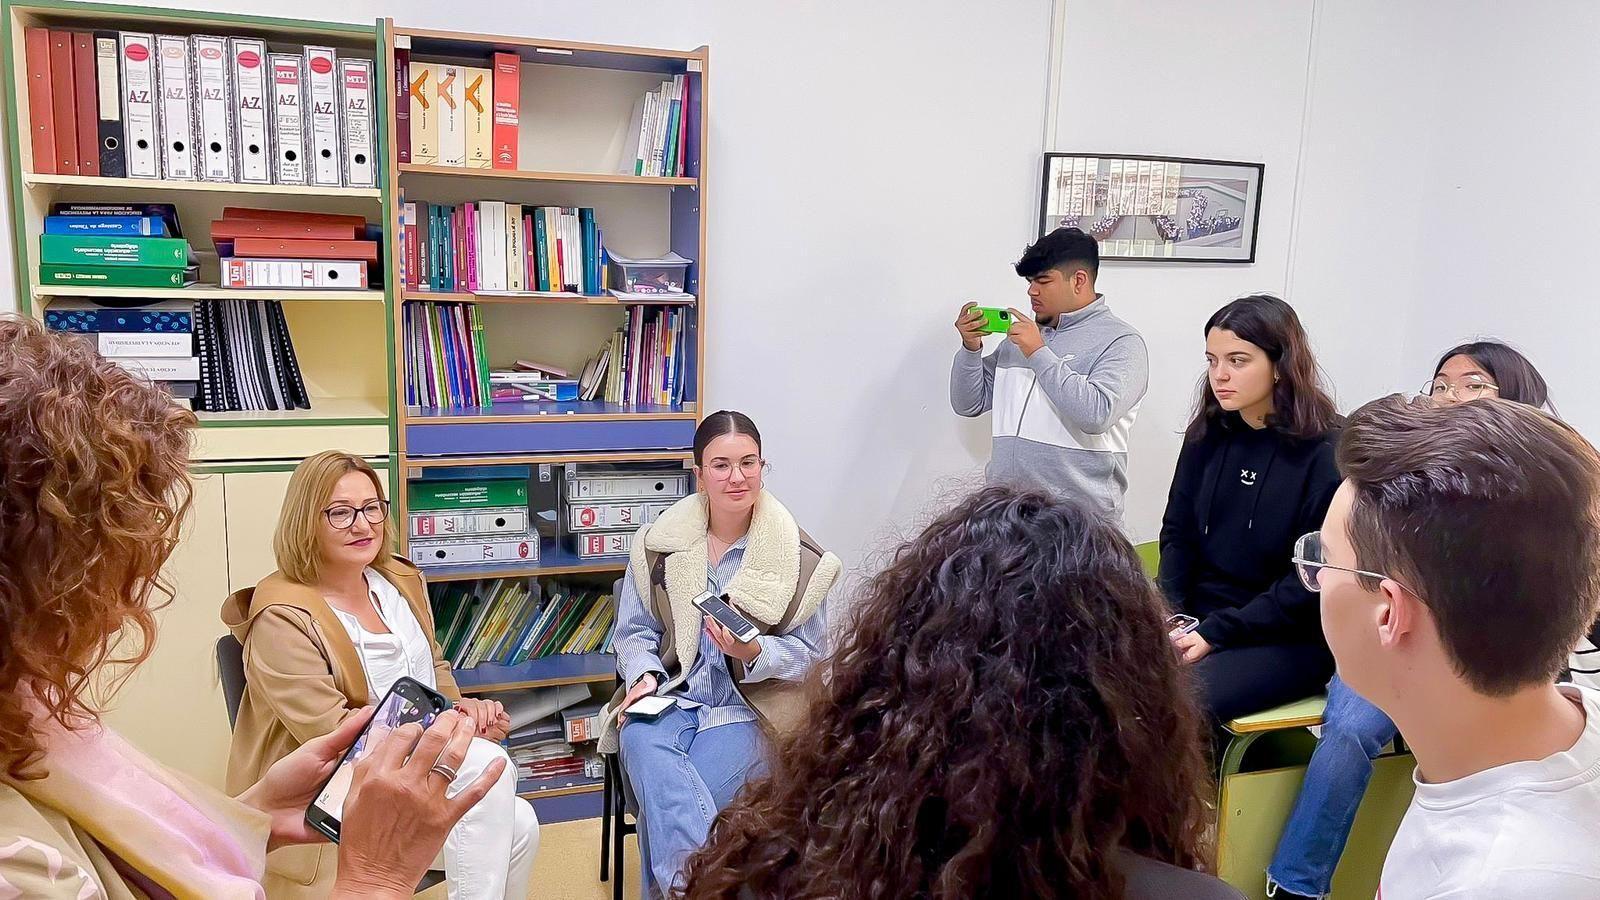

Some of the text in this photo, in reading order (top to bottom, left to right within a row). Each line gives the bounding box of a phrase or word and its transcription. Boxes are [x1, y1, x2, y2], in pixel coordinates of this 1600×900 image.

[276, 70, 297, 80] MTL
[346, 75, 366, 84] MTL
[129, 90, 150, 103] A-Z
[166, 88, 185, 100] A-Z
[203, 88, 223, 101] A-Z
[278, 94, 297, 106] A-Z
[241, 97, 261, 110] A-Z
[314, 102, 334, 114] A-Z
[348, 98, 367, 110] A-Z
[620, 508, 632, 524] A-Z
[444, 517, 455, 533] A-Z
[612, 536, 622, 551] A-Z
[482, 545, 494, 560] A-Z
